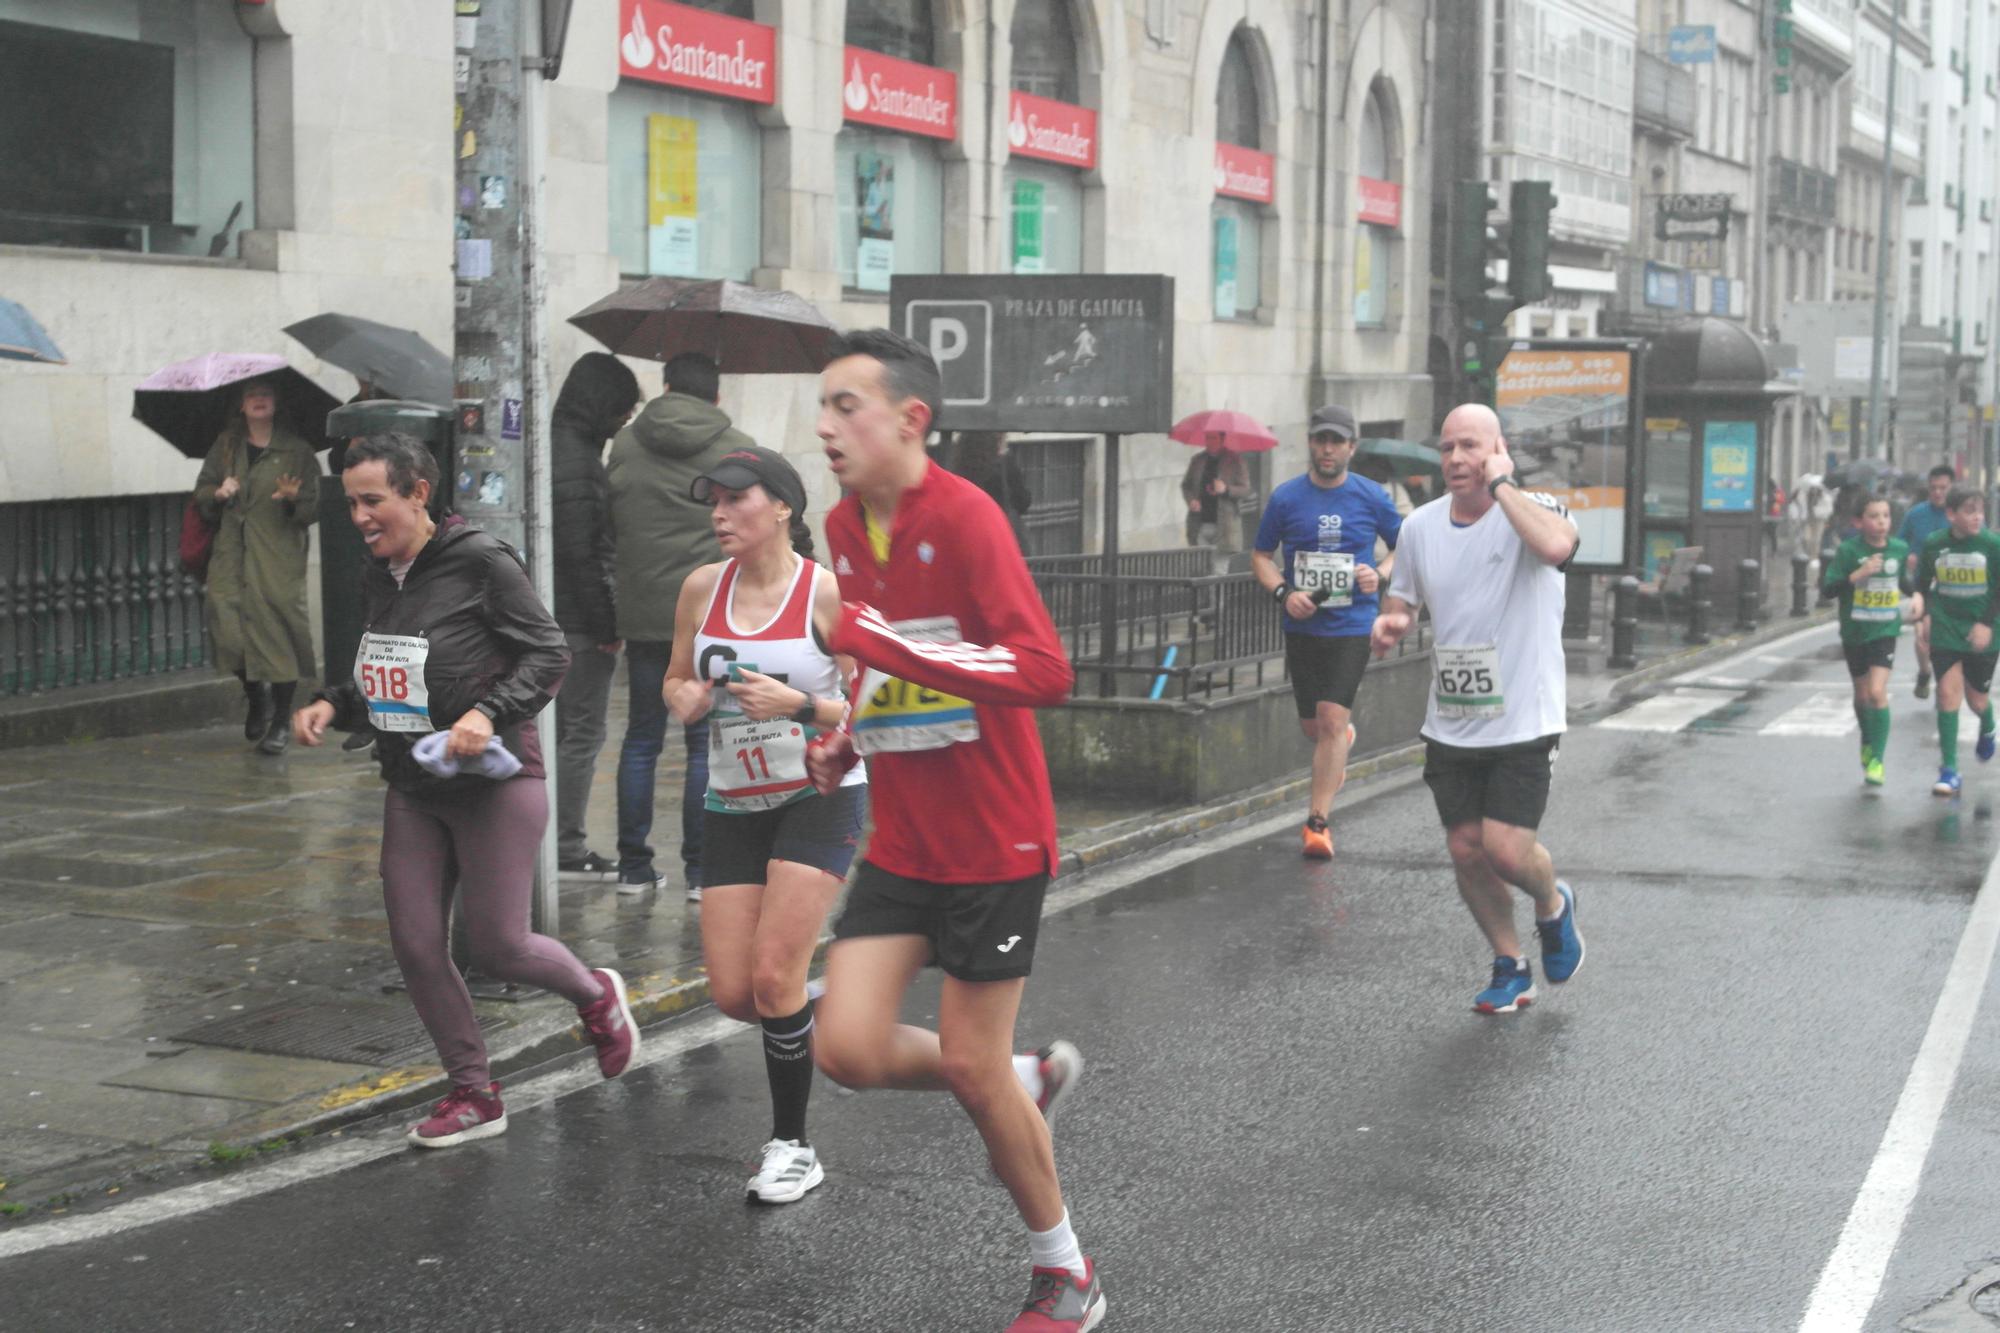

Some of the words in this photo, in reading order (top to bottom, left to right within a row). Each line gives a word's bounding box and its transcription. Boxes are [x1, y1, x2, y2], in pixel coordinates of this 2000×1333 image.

[656, 25, 766, 89] Santander
[870, 72, 949, 126] Santander
[1027, 113, 1091, 160] Santander
[1080, 299, 1144, 317] GALICIA
[930, 317, 969, 373] P
[1506, 356, 1574, 373] Mercado
[1318, 514, 1342, 529] 39
[1299, 568, 1349, 590] 1388
[362, 664, 408, 700] 518
[736, 746, 771, 781] 11
